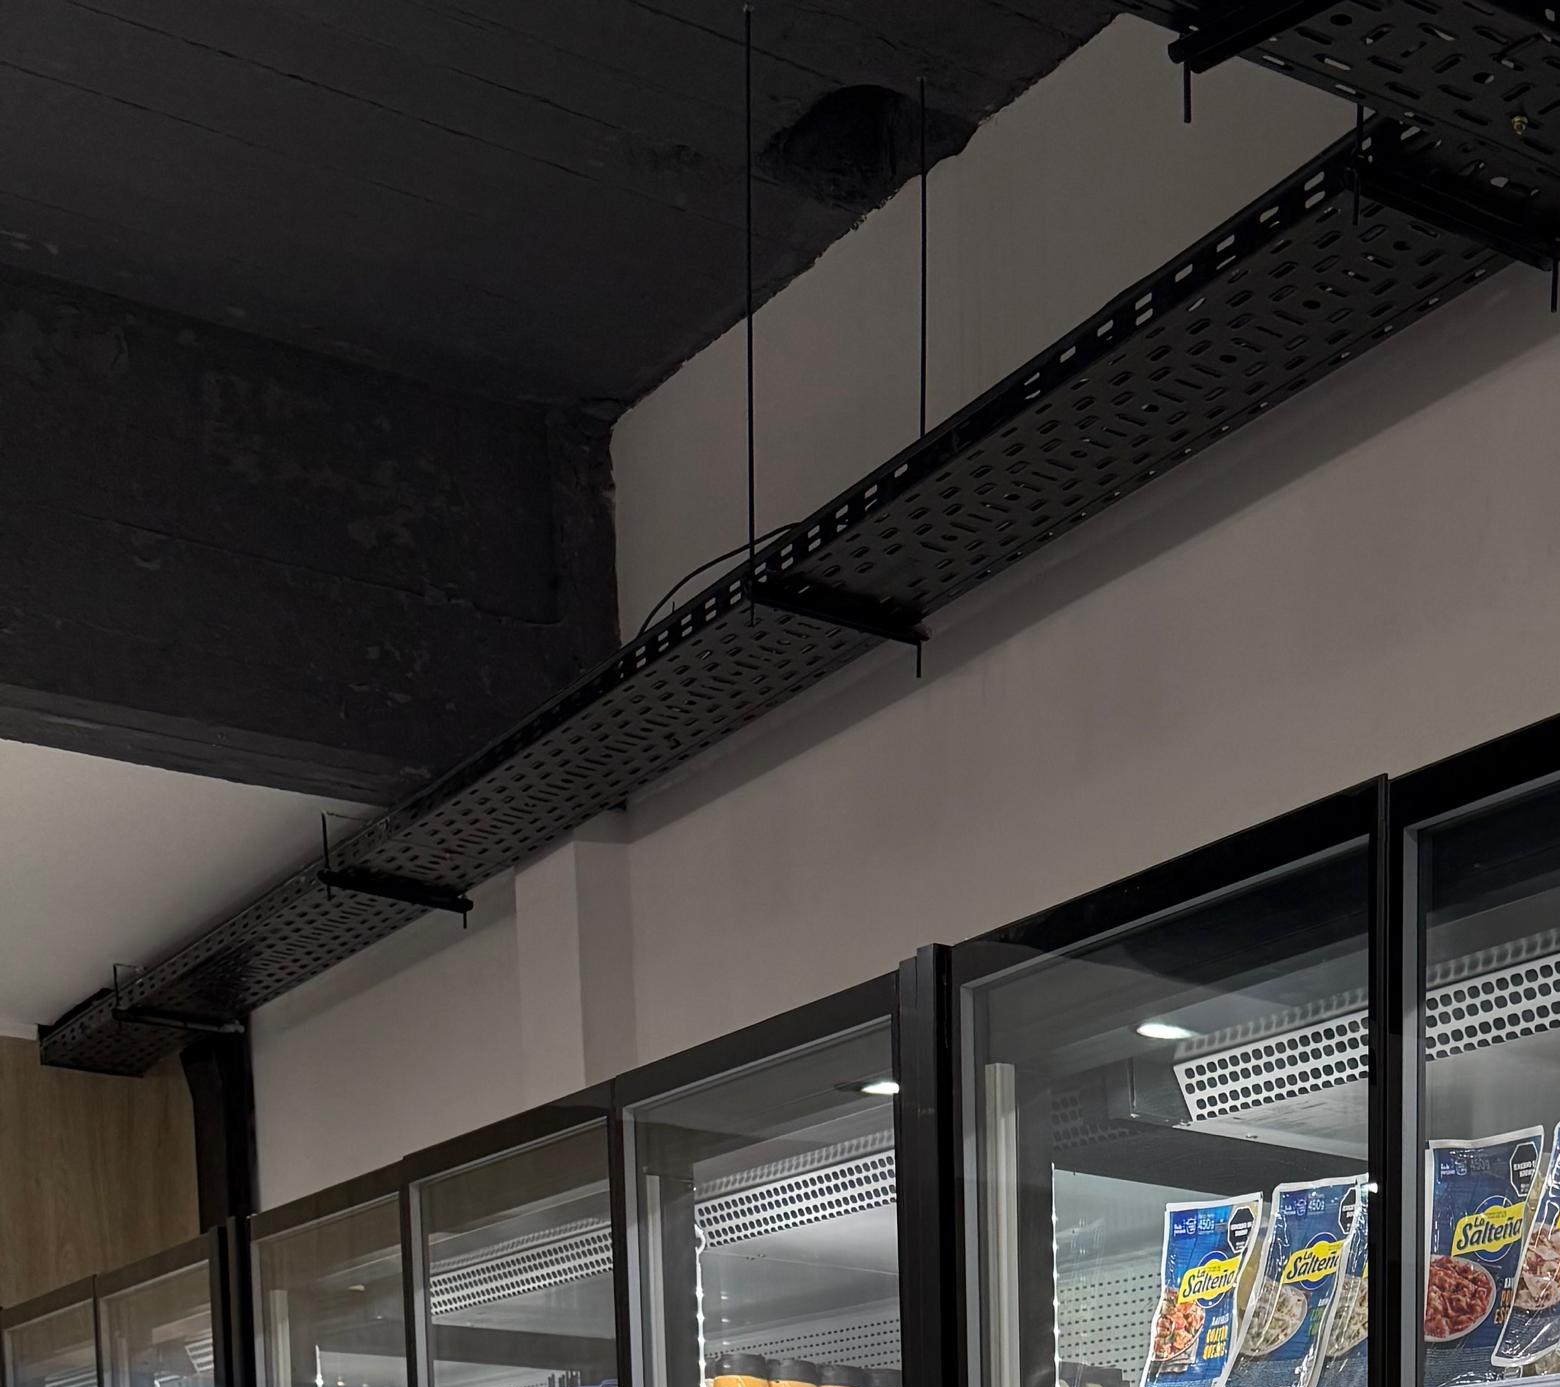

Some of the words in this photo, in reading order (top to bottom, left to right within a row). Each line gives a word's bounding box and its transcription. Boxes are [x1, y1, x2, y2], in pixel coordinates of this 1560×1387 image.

[1456, 1215, 1523, 1251] Salteña
[1474, 1216, 1485, 1226] La
[1183, 1270, 1235, 1298] Salteña
